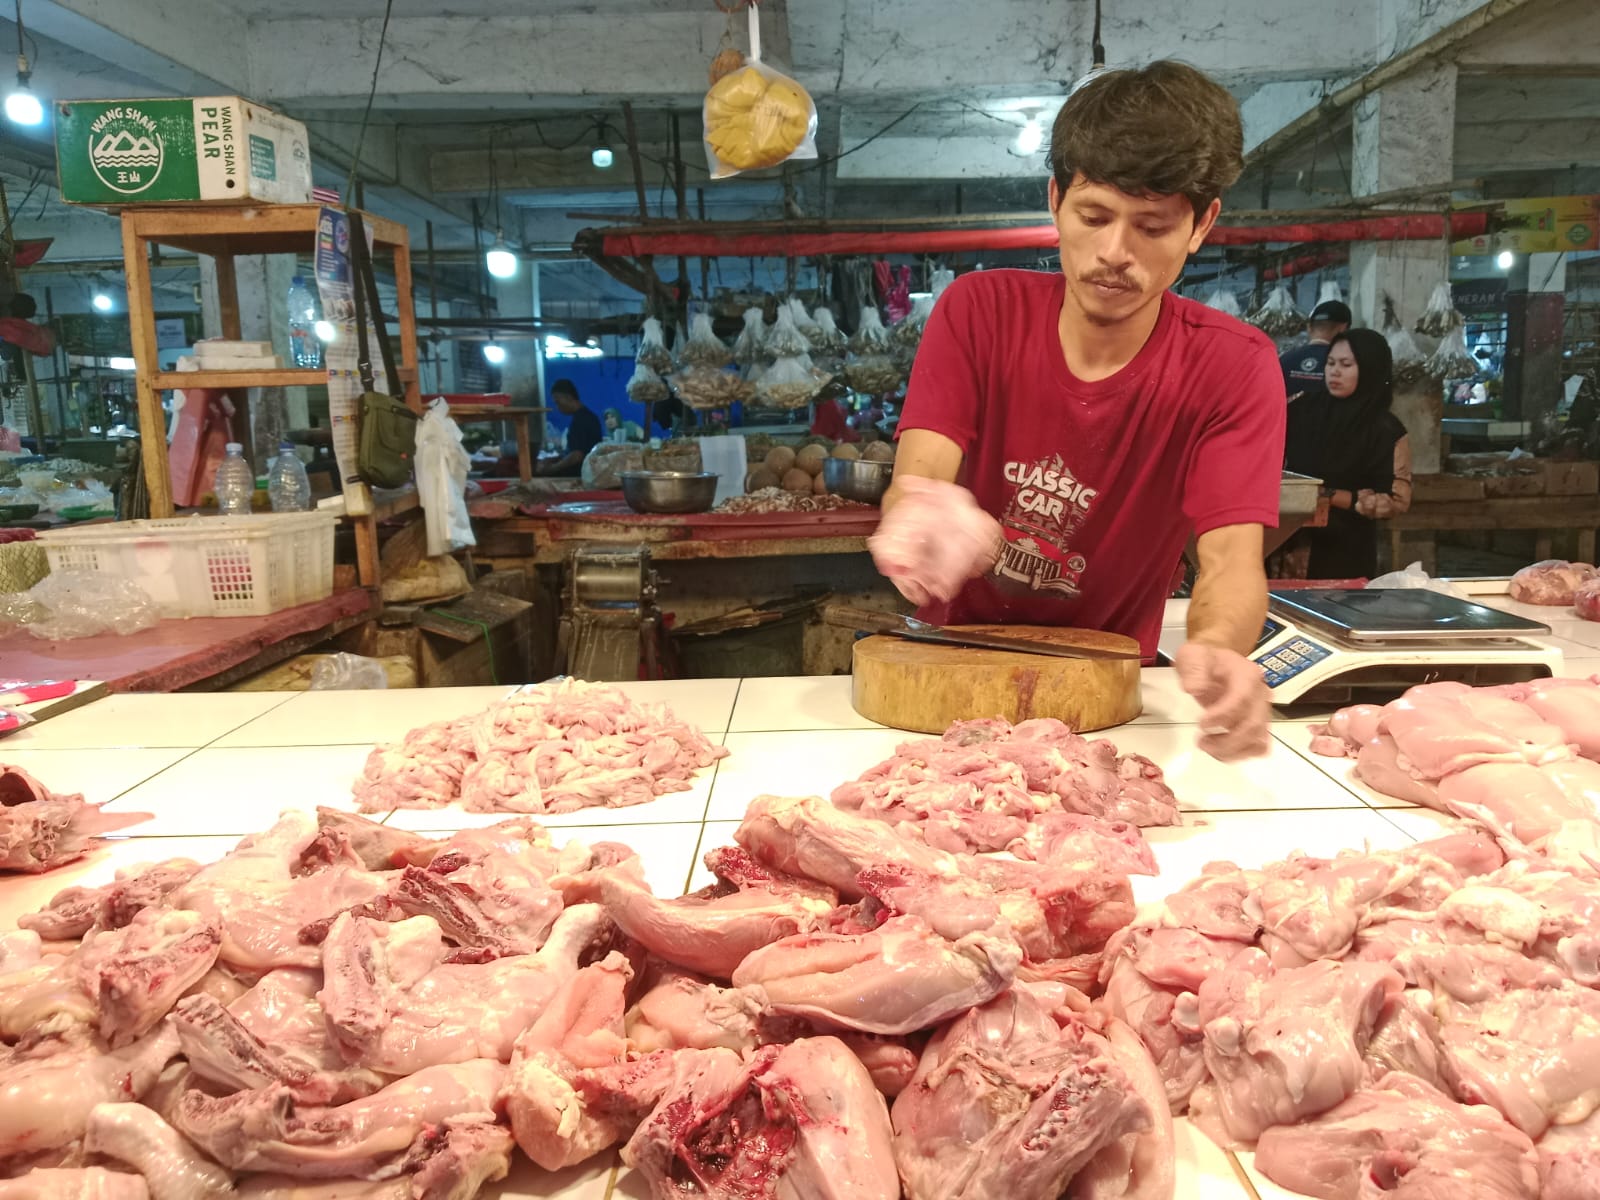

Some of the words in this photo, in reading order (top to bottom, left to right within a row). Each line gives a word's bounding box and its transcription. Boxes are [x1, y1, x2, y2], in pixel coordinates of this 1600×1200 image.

[91, 108, 123, 132] WANG
[126, 107, 157, 132] SHAN
[201, 107, 220, 158] PEAR
[221, 106, 233, 144] WANG
[117, 170, 140, 183] 王山
[223, 145, 235, 175] SHAN
[1004, 462, 1097, 509] CLASSIC
[1018, 489, 1063, 525] CAR
